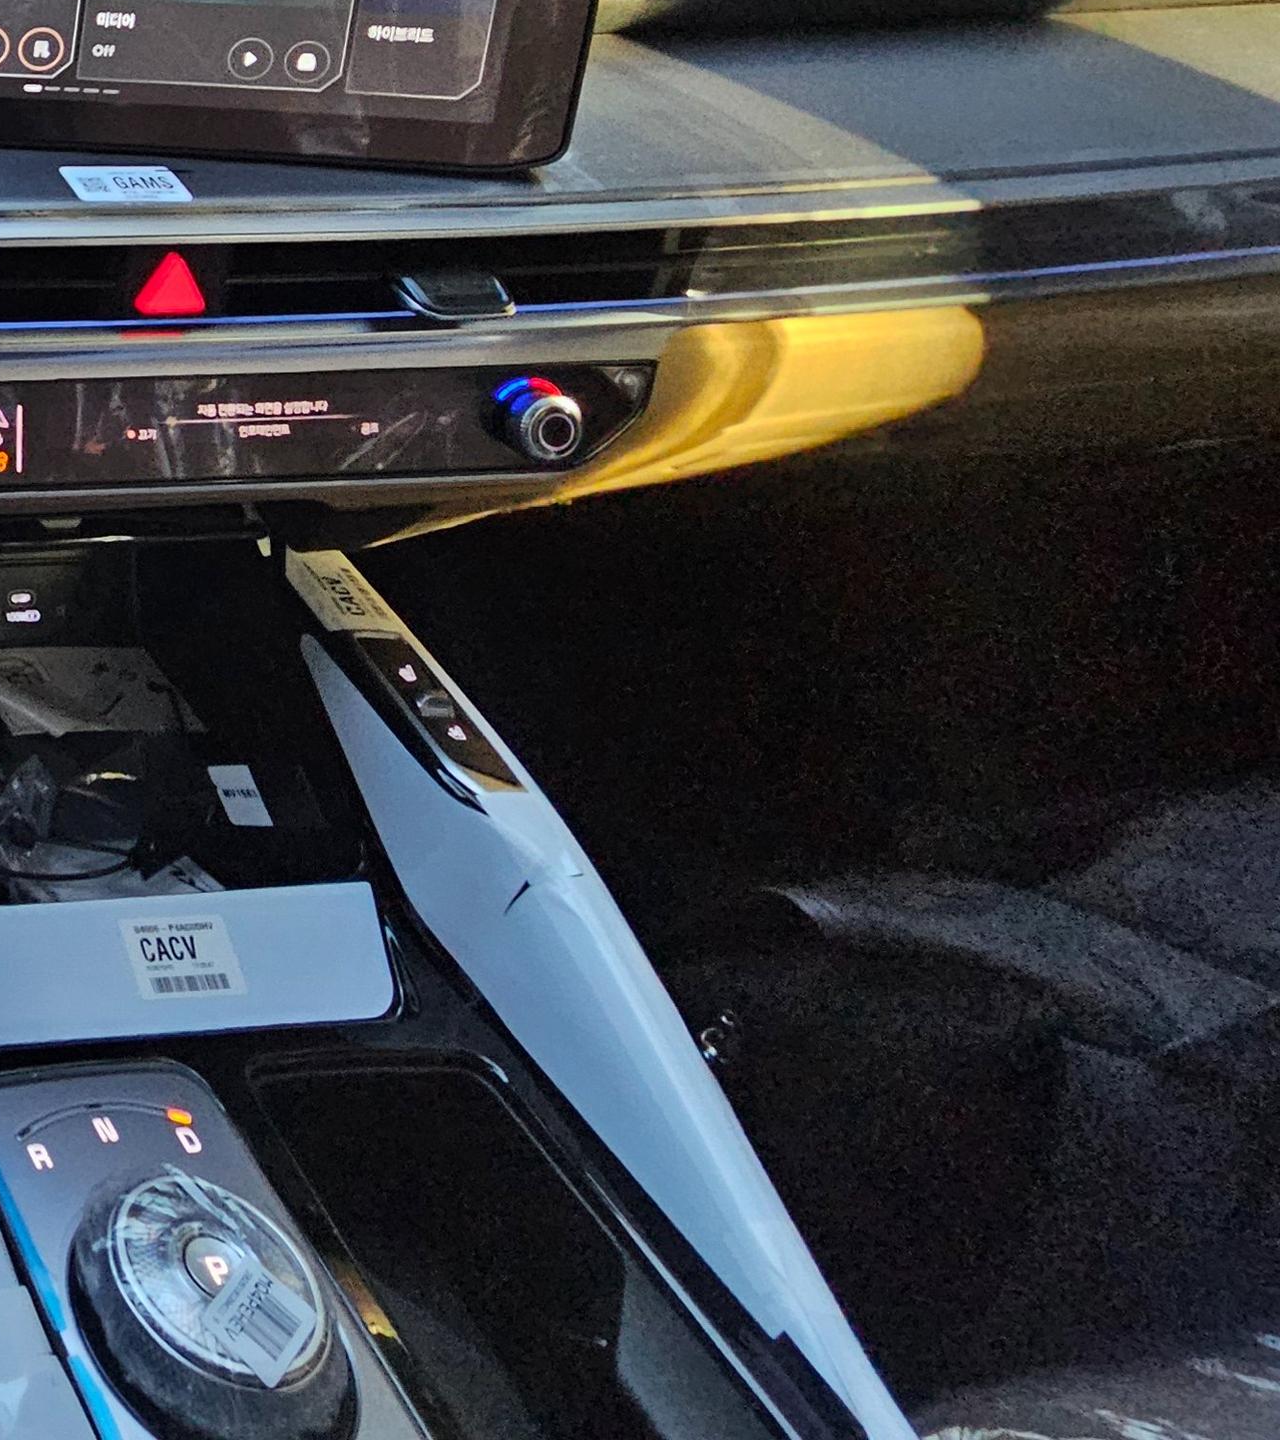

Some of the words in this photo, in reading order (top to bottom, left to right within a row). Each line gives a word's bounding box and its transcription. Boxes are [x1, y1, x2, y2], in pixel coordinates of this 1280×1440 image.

[92, 44, 115, 57] Off
[112, 176, 174, 190] GAMS
[140, 935, 197, 962] CACV
[26, 1143, 53, 1170] R
[92, 1116, 119, 1143] N
[176, 1126, 202, 1154] D
[204, 1255, 228, 1286] P
